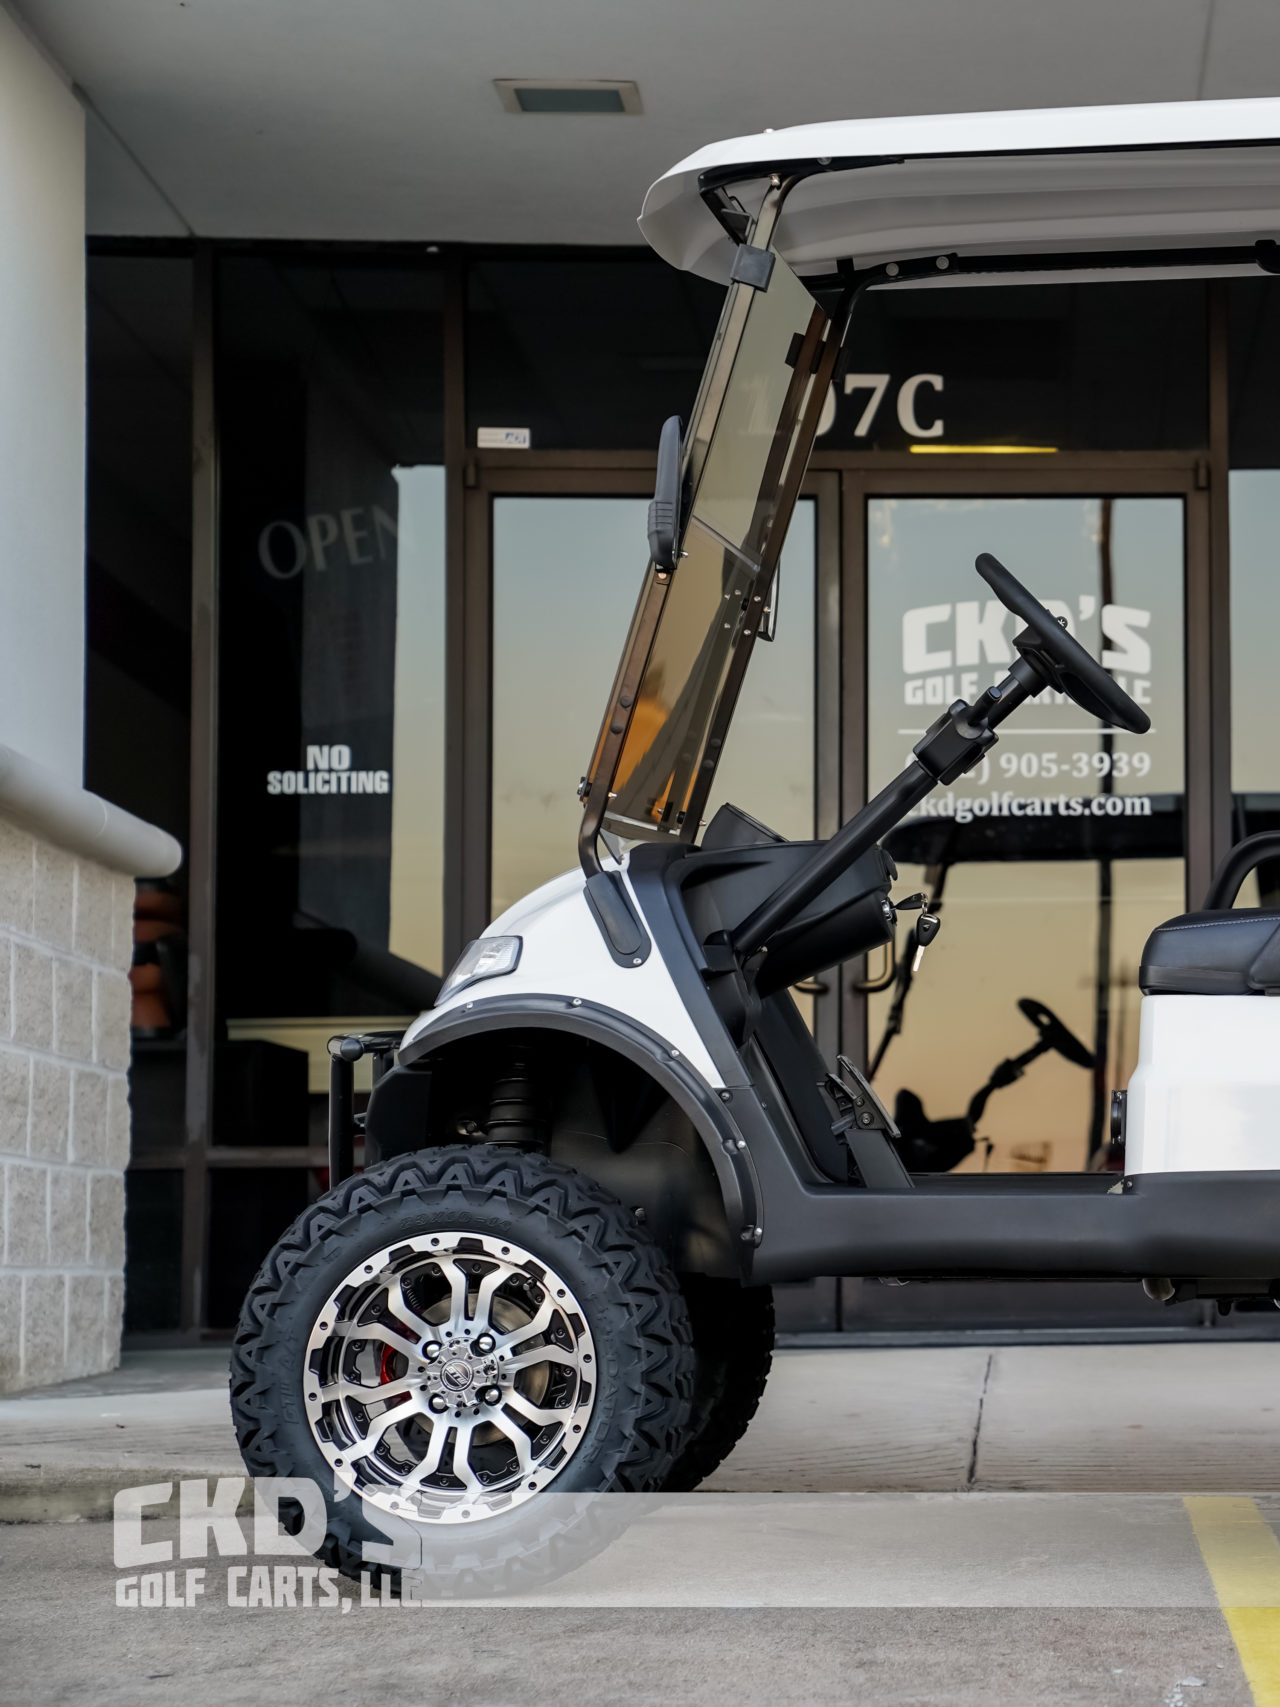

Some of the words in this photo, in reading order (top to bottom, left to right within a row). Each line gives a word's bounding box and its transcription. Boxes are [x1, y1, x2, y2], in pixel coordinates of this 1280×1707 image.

[904, 671, 978, 705] GOLF
[306, 744, 351, 770] NO
[999, 752, 1152, 778] 905-3939
[266, 770, 390, 794] SOLICITING
